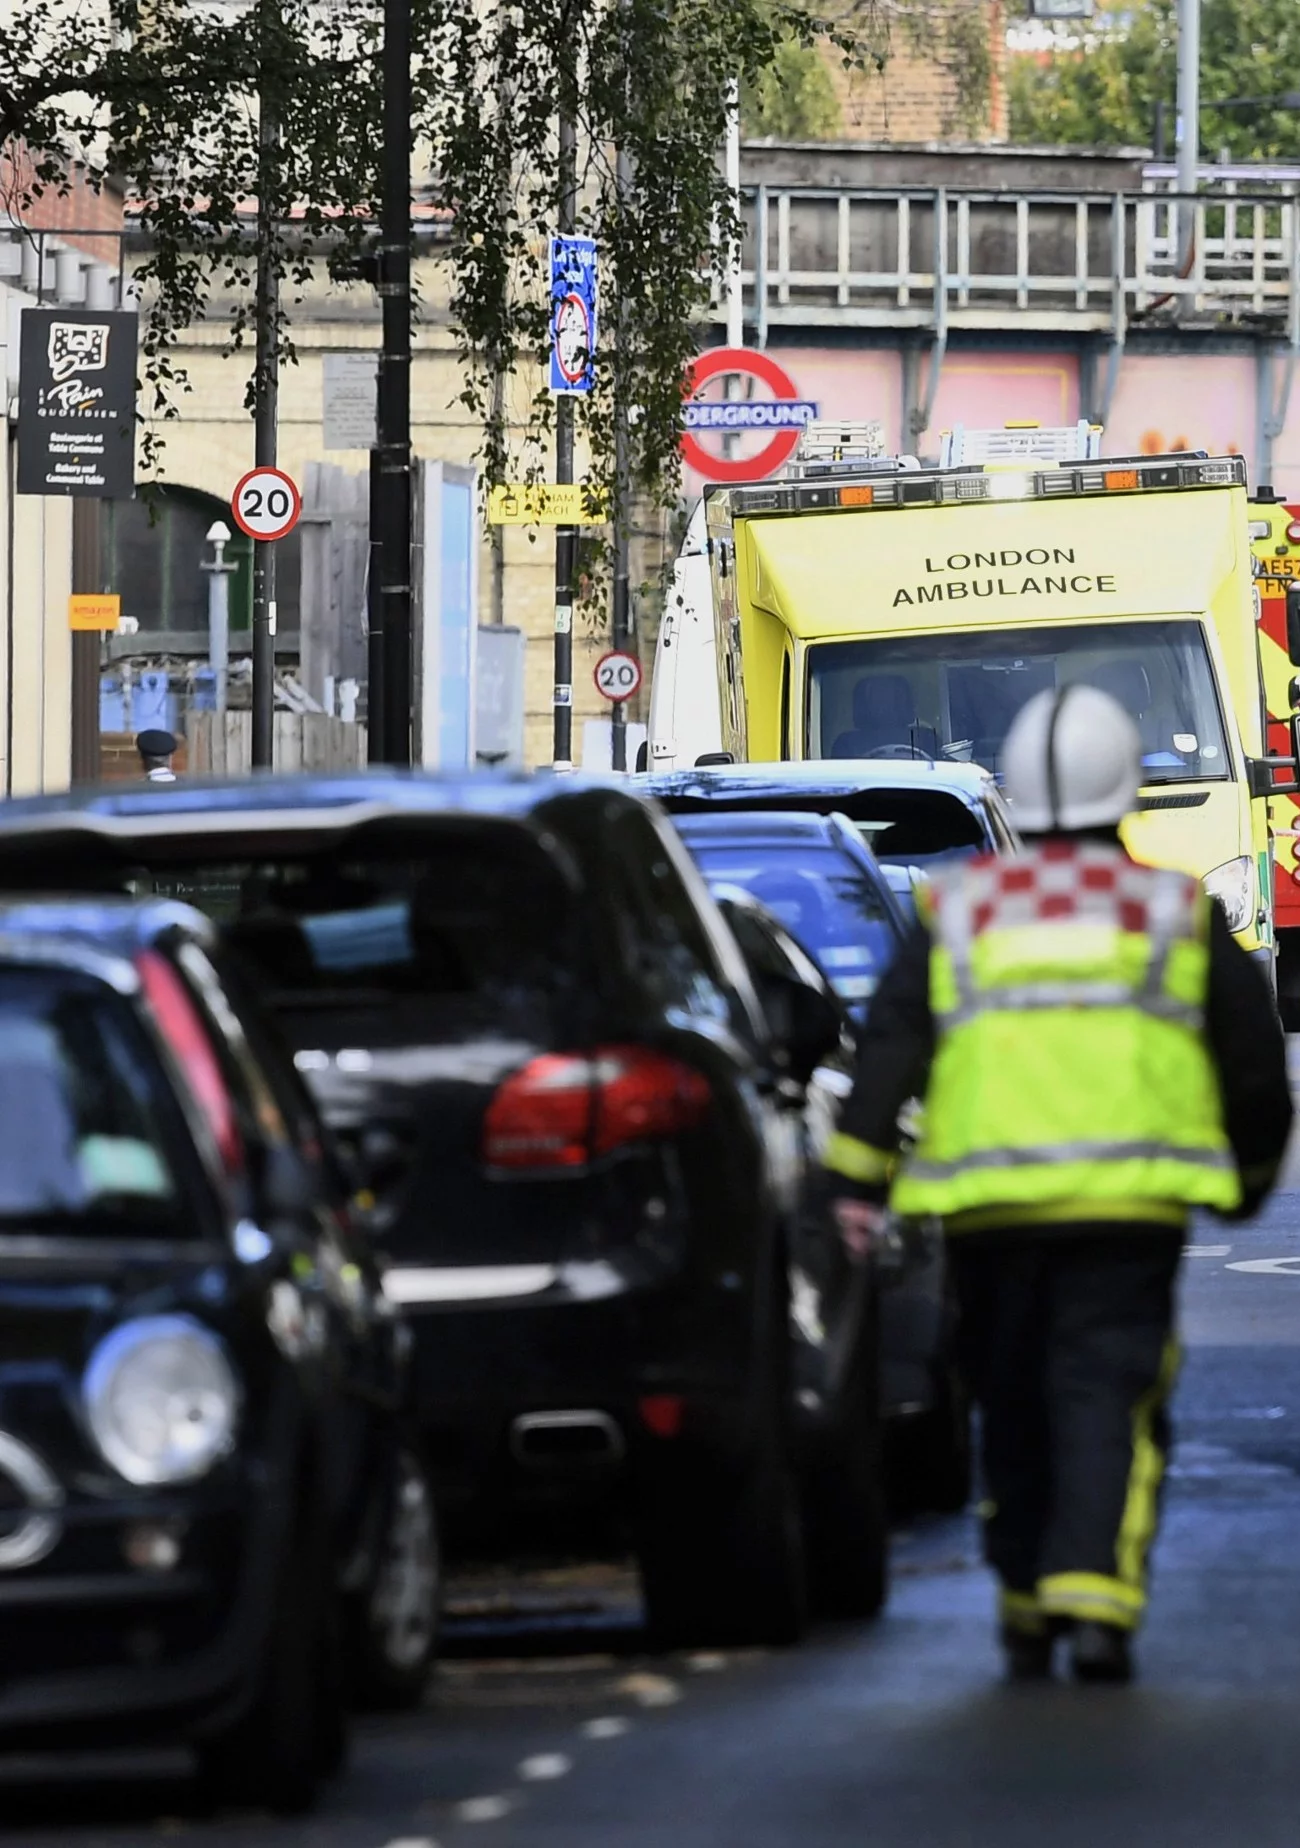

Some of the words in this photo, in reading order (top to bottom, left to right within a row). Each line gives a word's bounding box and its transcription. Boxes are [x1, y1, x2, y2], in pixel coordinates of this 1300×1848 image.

[47, 379, 104, 410] Pain
[37, 408, 118, 418] QUOTIDIEN
[685, 405, 814, 426] DERGROUND
[243, 488, 290, 518] 20
[925, 548, 1076, 573] LONDON
[892, 575, 1117, 607] AMBULANCE
[601, 665, 634, 687] 20
